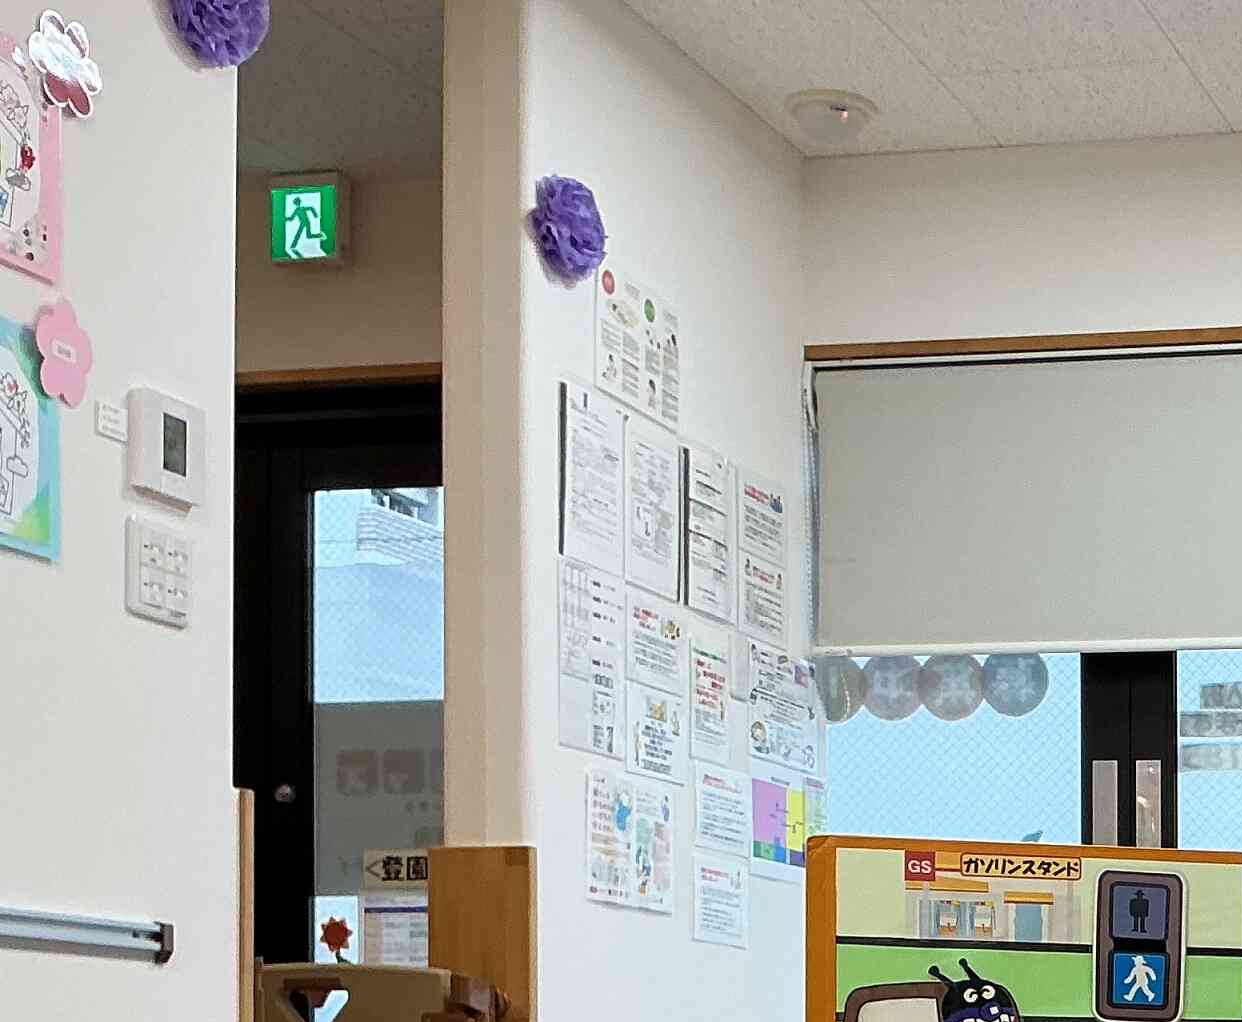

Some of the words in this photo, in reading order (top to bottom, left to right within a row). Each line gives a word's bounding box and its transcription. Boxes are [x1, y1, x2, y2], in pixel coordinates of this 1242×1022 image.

[907, 860, 932, 873] GS
[963, 857, 1079, 877] ガソリンスタンド
